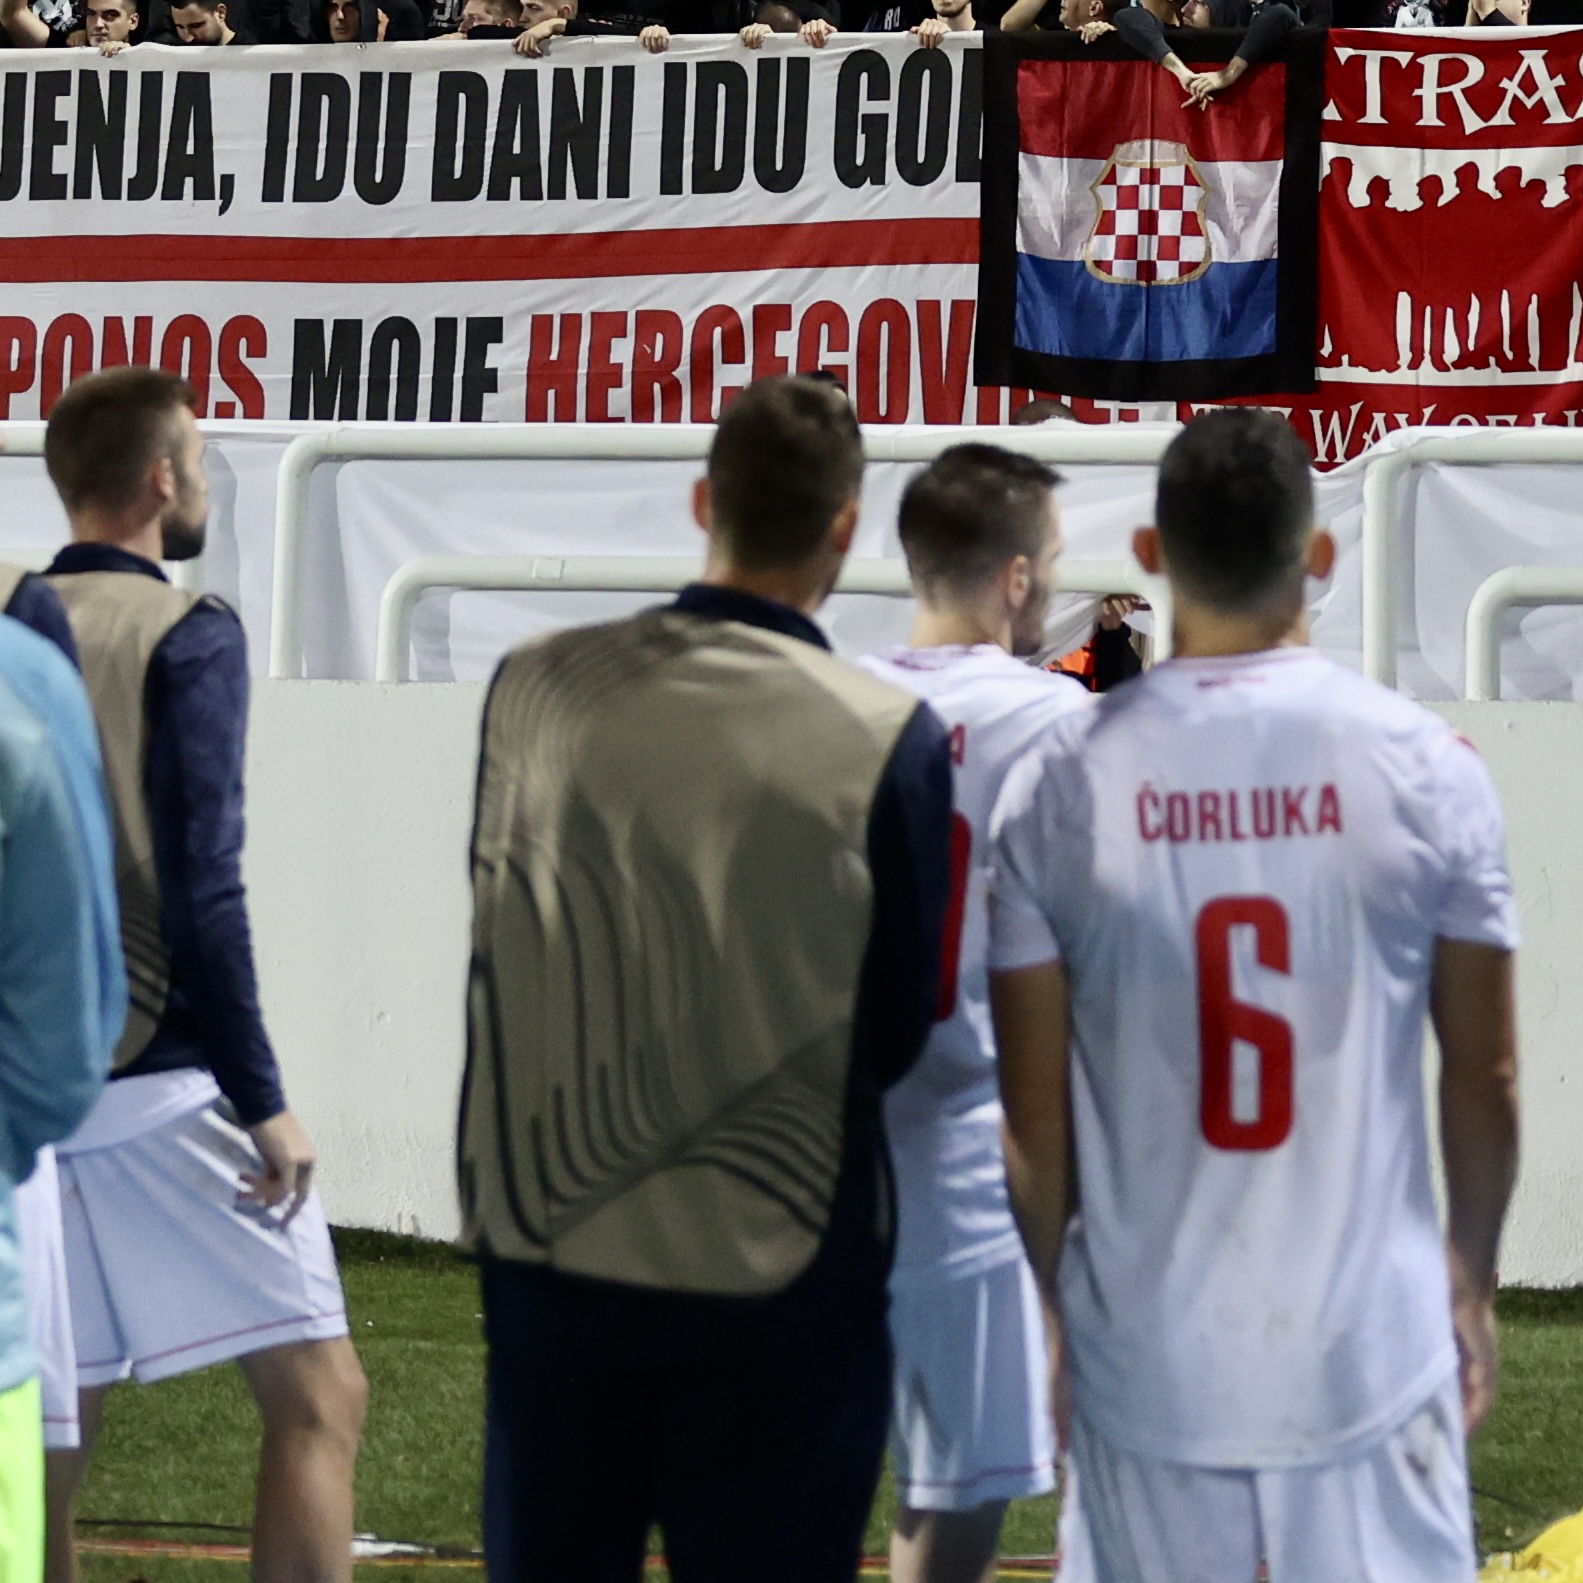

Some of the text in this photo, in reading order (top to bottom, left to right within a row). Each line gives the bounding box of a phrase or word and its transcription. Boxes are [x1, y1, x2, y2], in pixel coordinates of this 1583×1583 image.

[261, 71, 412, 206] IDU
[430, 64, 636, 203] DANI
[660, 55, 815, 196] IDU
[1194, 894, 1296, 1152] 6
